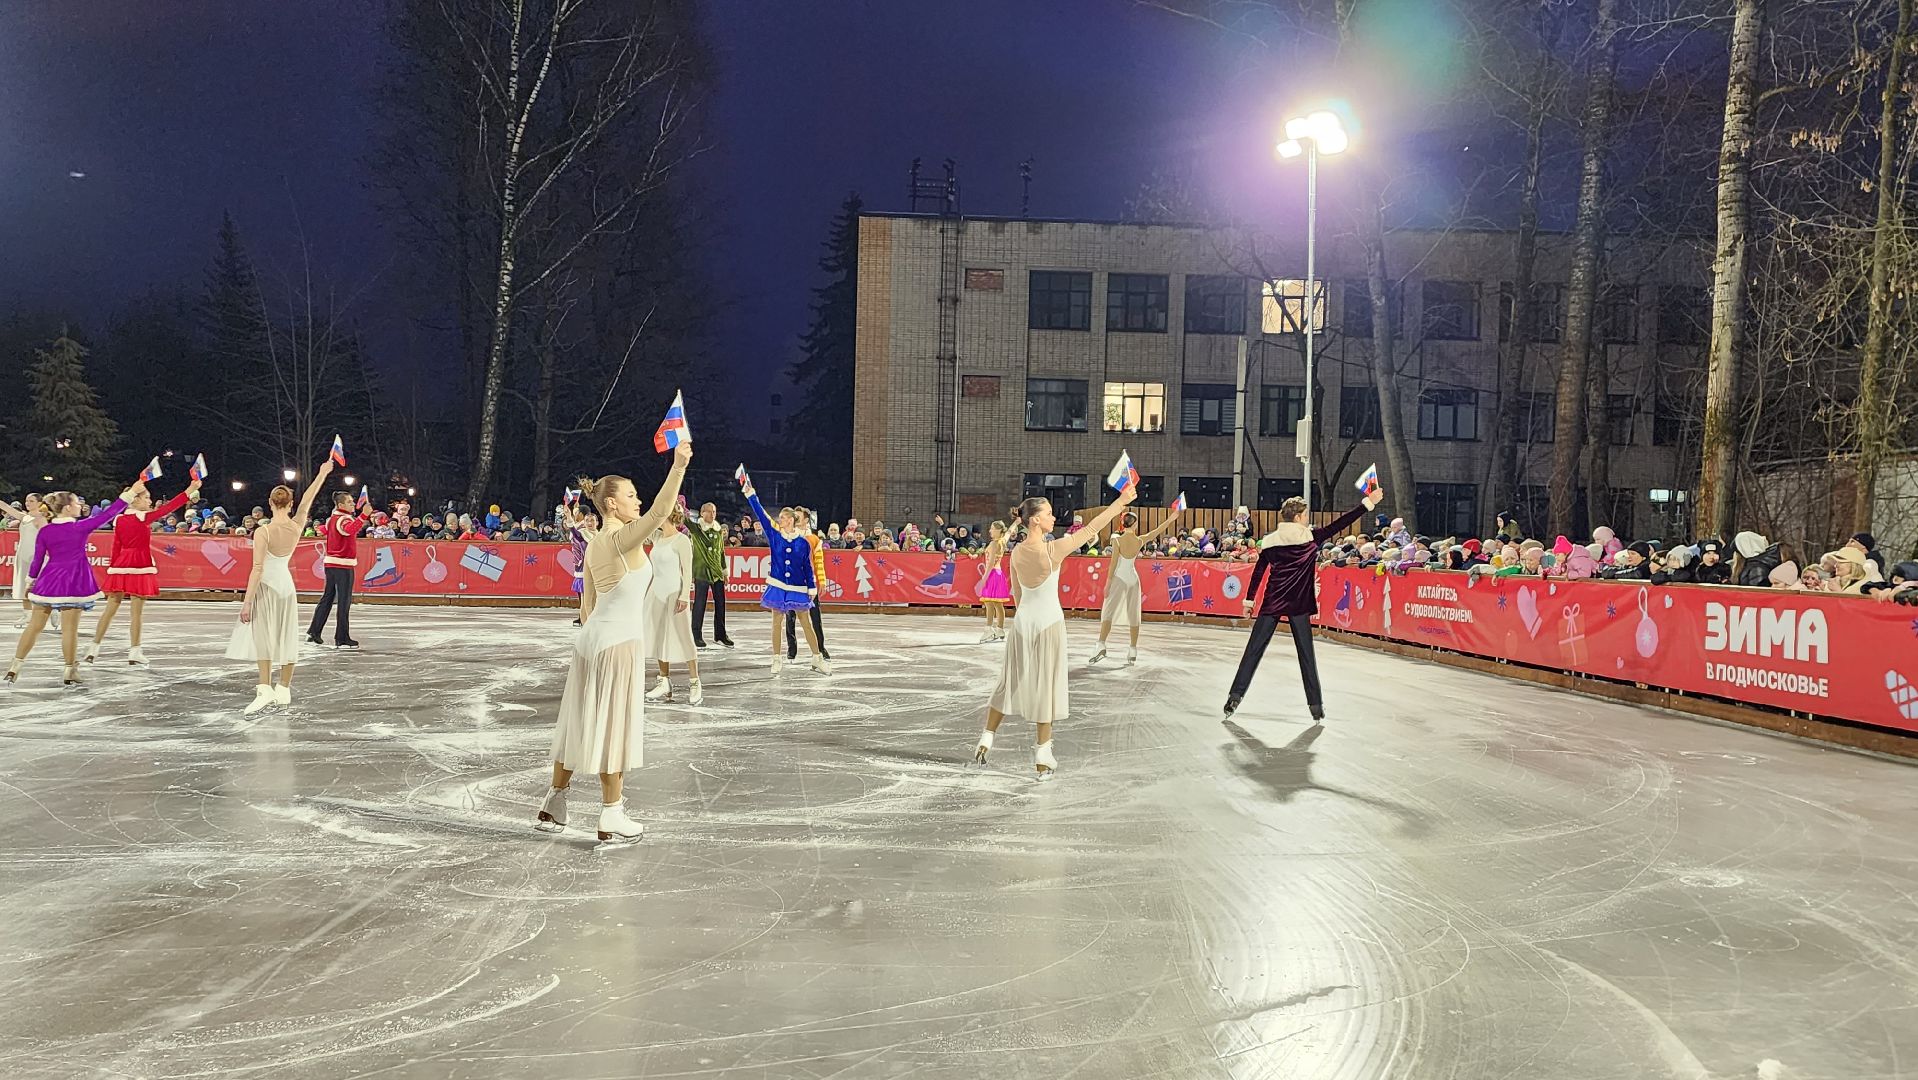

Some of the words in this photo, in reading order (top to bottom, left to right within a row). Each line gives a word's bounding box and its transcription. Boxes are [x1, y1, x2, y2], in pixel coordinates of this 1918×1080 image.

[1418, 584, 1458, 601] КАТАЙТЕСЬ
[1405, 603, 1410, 615] С
[1411, 604, 1473, 623] УДОВОЛЬСТВИЕМ!
[1705, 602, 1829, 664] ЗИМА
[1706, 662, 1714, 679] В
[1716, 664, 1829, 698] ПОДМОСКОВЬЕ
